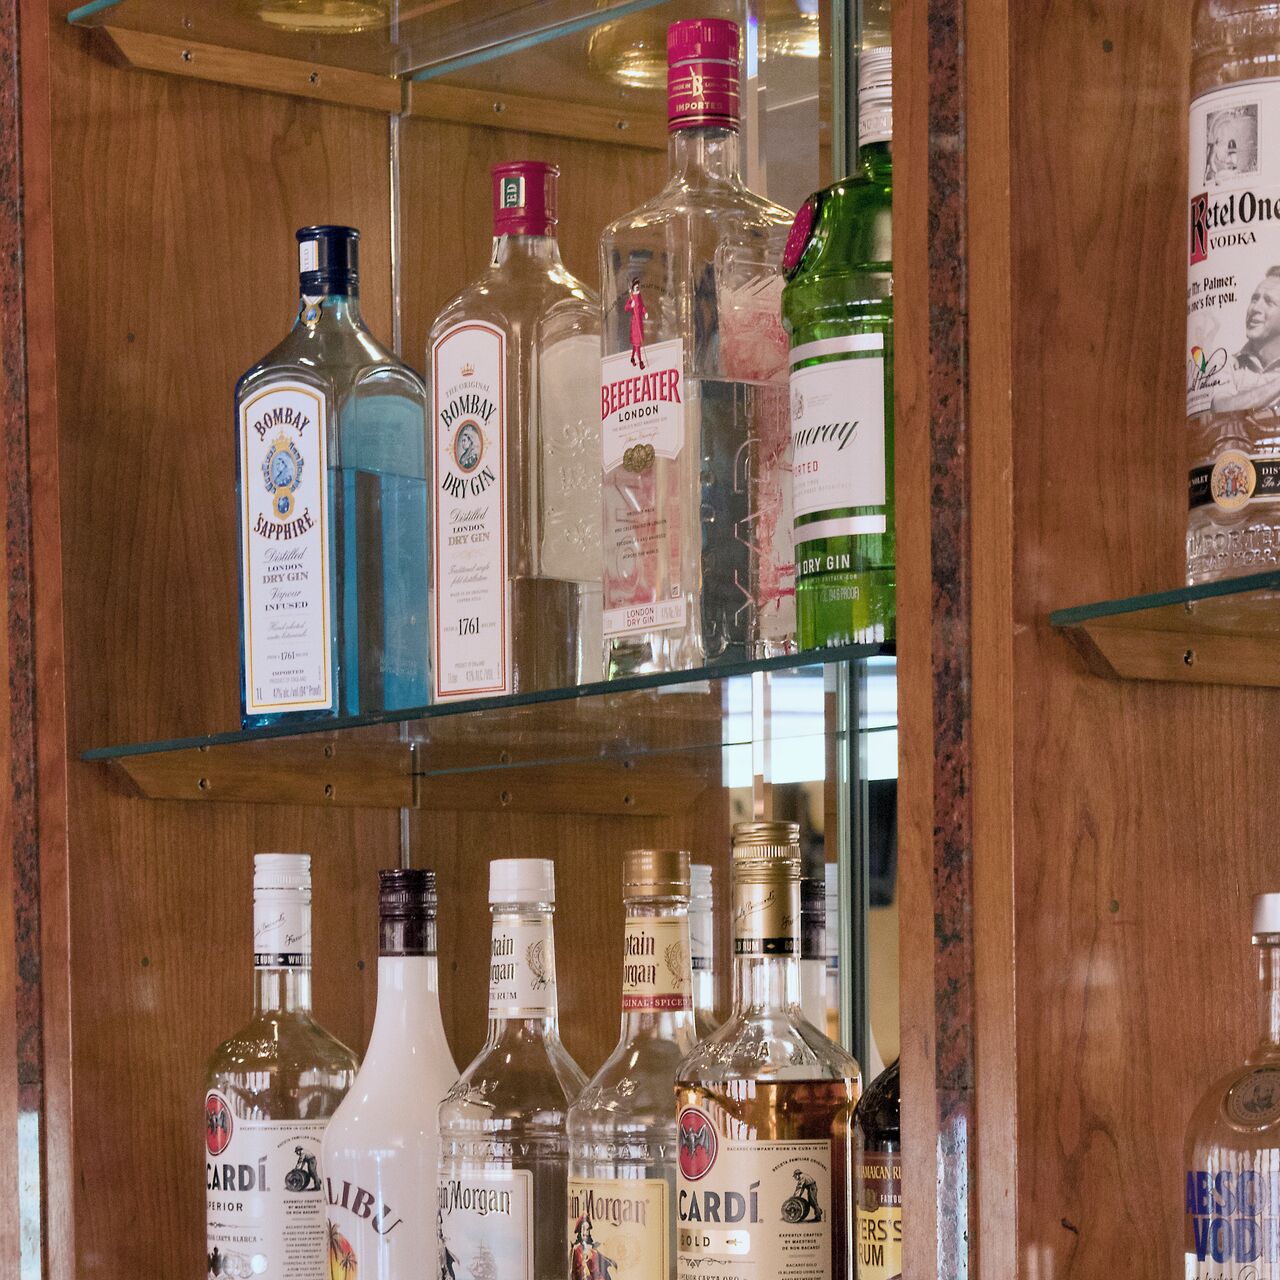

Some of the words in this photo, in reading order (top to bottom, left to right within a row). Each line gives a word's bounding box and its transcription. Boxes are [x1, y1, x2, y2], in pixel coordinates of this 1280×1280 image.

[1191, 194, 1236, 256] Ketel
[1209, 231, 1257, 250] VODKA
[1203, 275, 1237, 293] Palmer,
[1205, 295, 1216, 307] for
[1218, 292, 1237, 309] you.
[459, 381, 490, 393] ORIGINAL
[601, 368, 682, 422] BEEFEATER
[440, 394, 497, 431] BOMBAY
[618, 404, 659, 422] LONDON
[254, 407, 310, 442] BOMBAY
[441, 471, 469, 499] DRY
[470, 465, 496, 497] GIN
[254, 507, 315, 541] SAPPHIRE
[449, 507, 489, 525] Distilled
[453, 523, 485, 534] LONDON
[448, 534, 469, 546] DRY
[470, 532, 491, 542] GIN
[263, 547, 308, 563] Distilled
[267, 563, 304, 572] LONDON
[803, 557, 821, 575] DRY
[826, 554, 851, 570] GIN
[262, 573, 285, 584] DRY
[287, 571, 309, 582] GIN
[265, 601, 309, 611] INFUSED
[626, 607, 655, 618] LONDON
[458, 616, 480, 637] 1761
[626, 618, 641, 628] DRY
[642, 615, 655, 624] GIN
[280, 651, 295, 661] 1761
[496, 991, 517, 1001] RUM
[325, 1176, 404, 1235] LIBU
[448, 1180, 513, 1217] Morgan
[677, 1179, 761, 1224] CARDÍ
[580, 1189, 647, 1228] Morgan
[680, 1234, 711, 1247] GOLD
[858, 1244, 884, 1267] RUM
